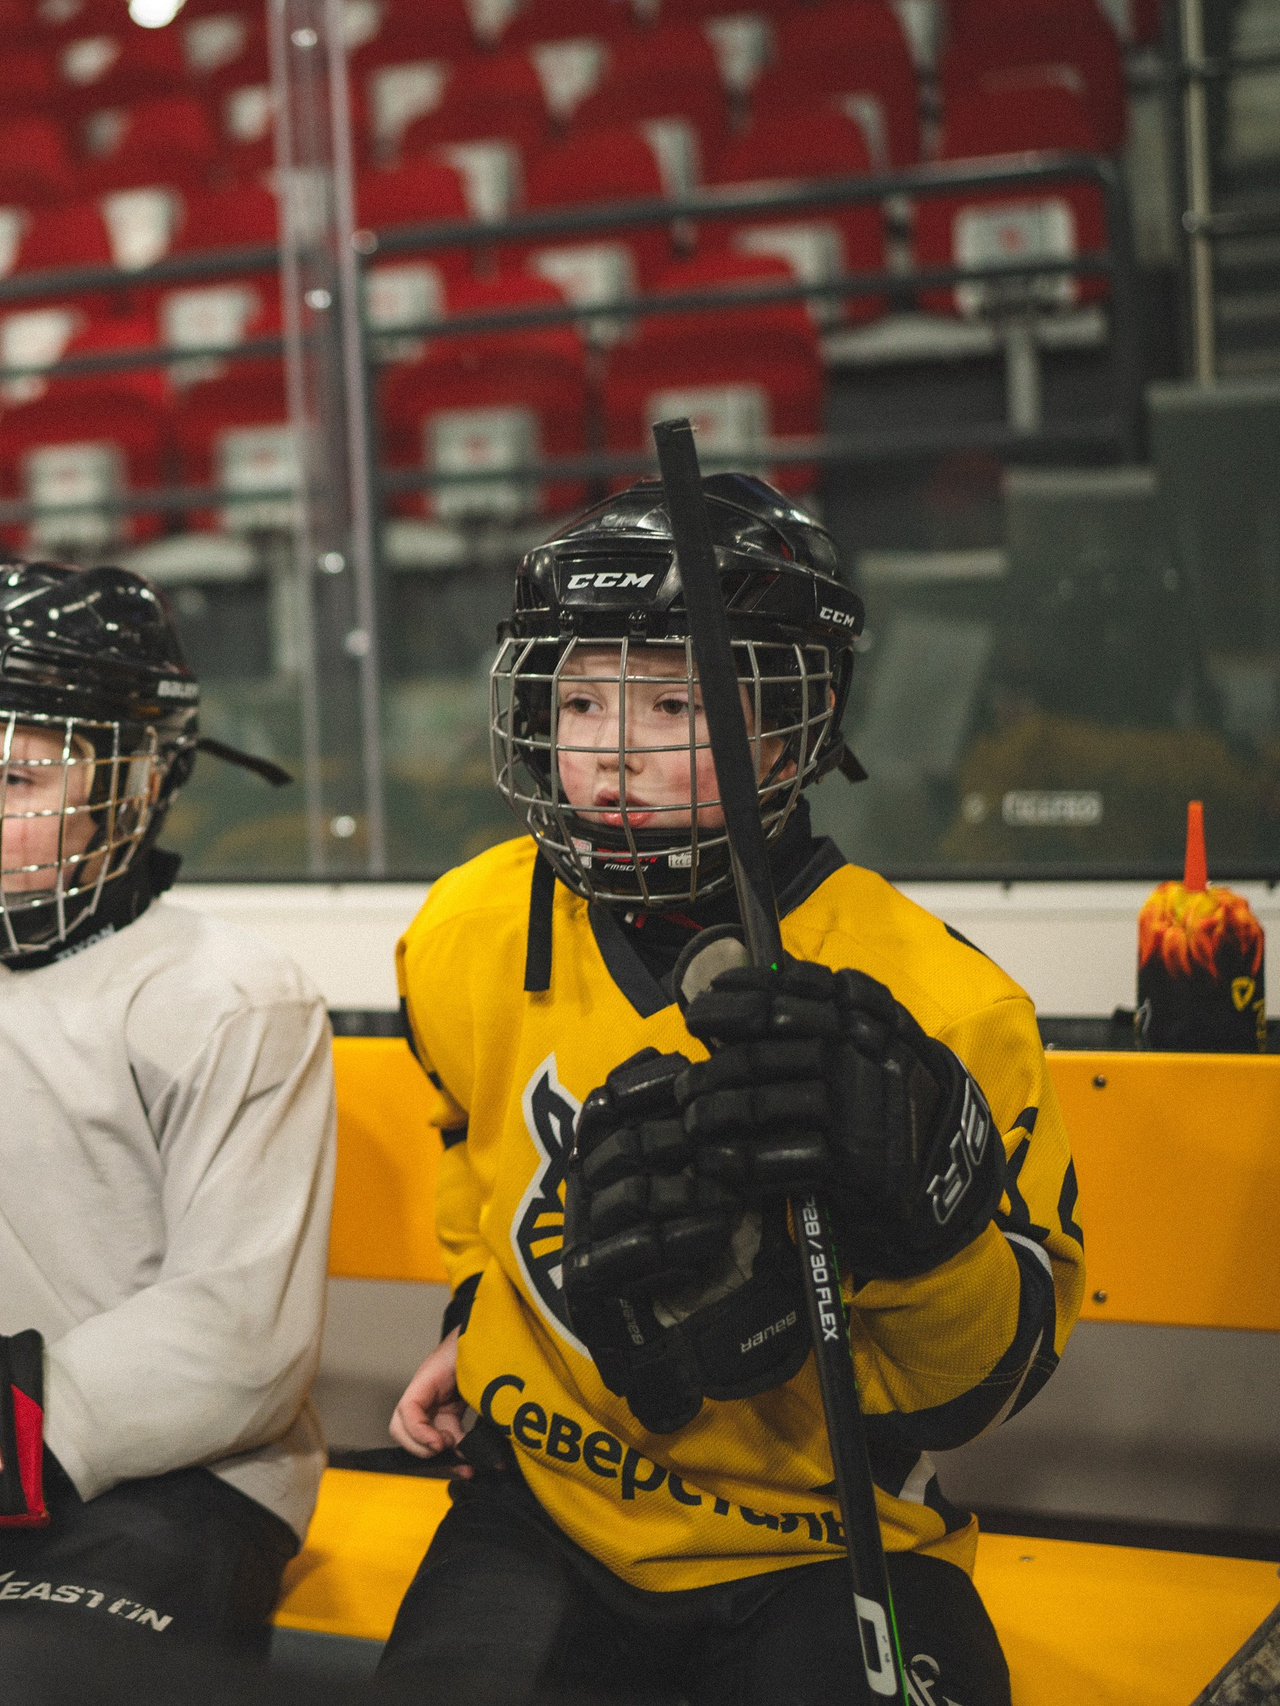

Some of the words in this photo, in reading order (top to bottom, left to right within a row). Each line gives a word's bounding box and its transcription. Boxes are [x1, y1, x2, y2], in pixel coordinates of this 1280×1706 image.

[567, 572, 654, 590] CCM
[820, 606, 855, 628] CCM
[740, 1310, 797, 1353] BAUER
[816, 1287, 839, 1341] FLEX
[480, 1374, 848, 1549] Северсаль
